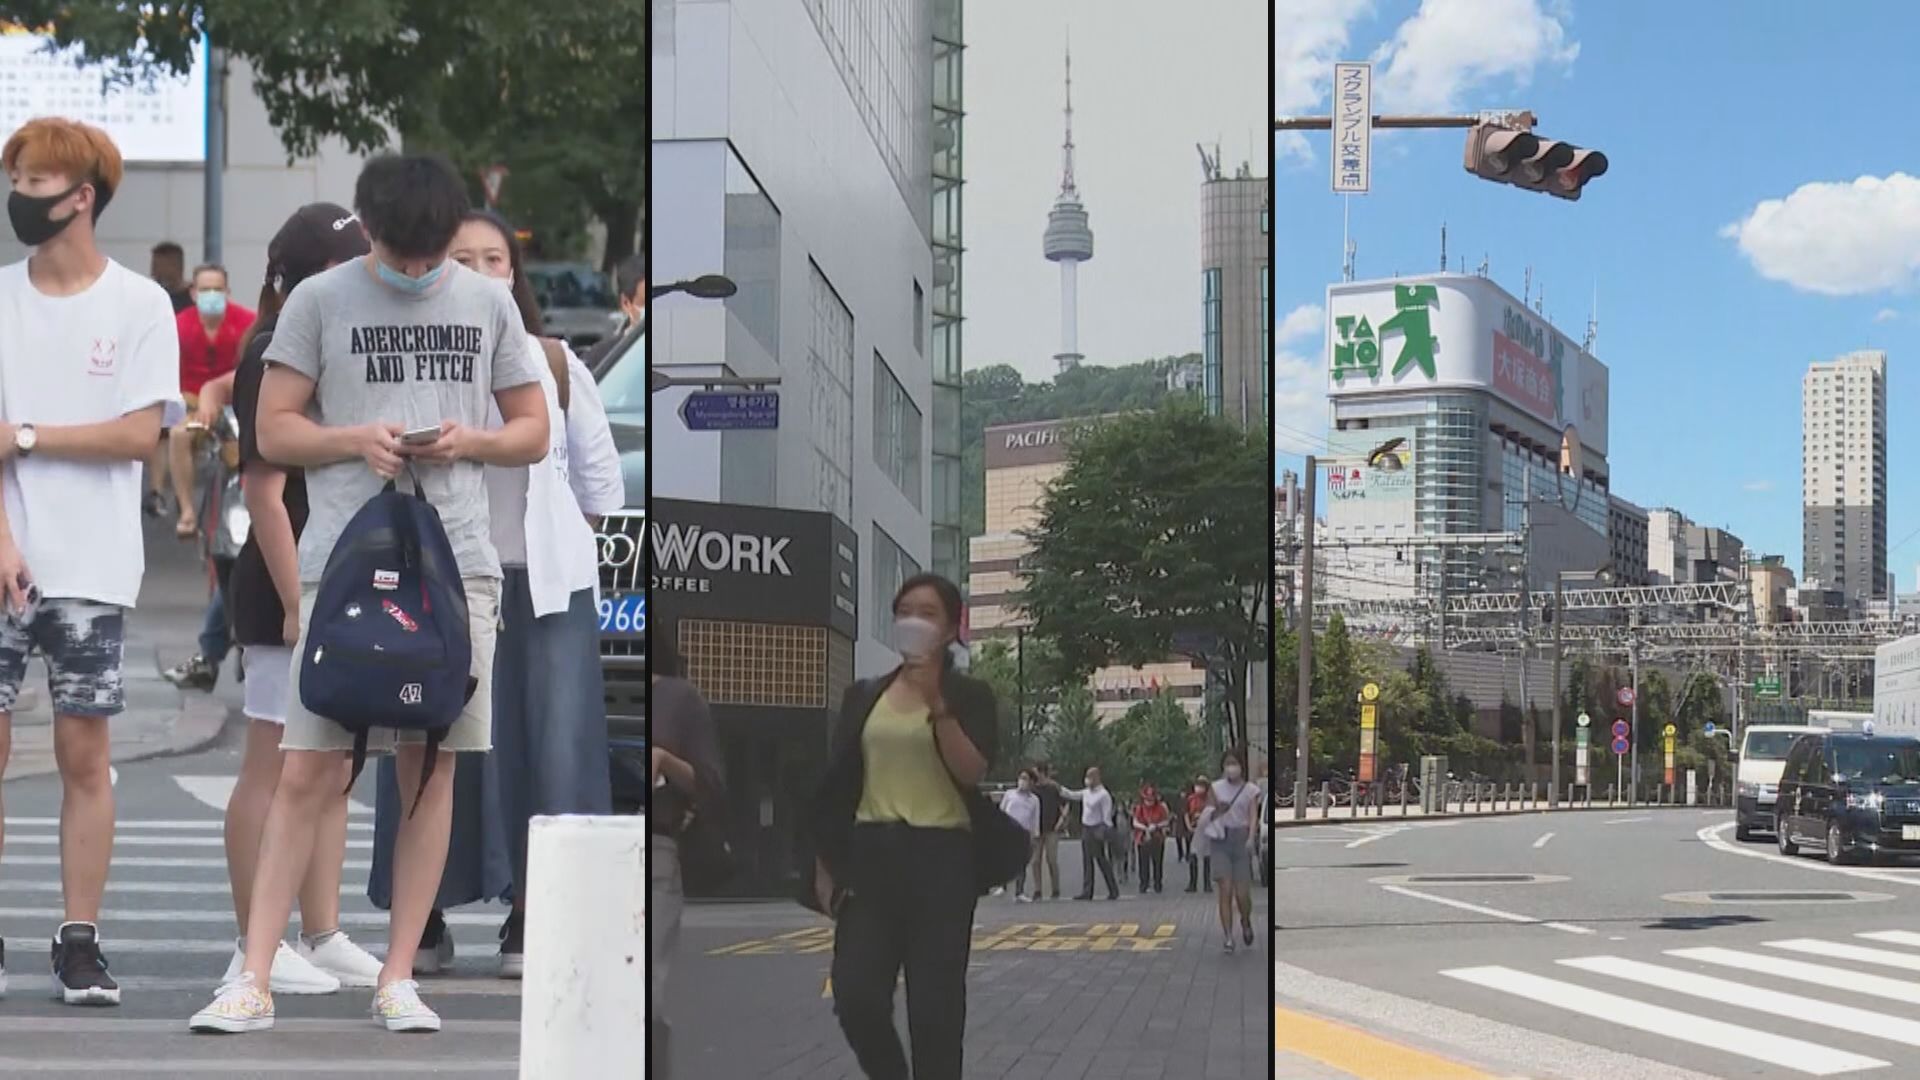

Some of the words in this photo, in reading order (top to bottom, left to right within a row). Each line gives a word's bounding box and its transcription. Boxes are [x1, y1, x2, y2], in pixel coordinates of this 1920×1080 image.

[1341, 68, 1362, 186] スクランブル交差点
[351, 324, 482, 354] ABERCROMBIE
[366, 354, 405, 383] AND
[414, 353, 474, 383] FITCH
[600, 599, 645, 631] 966
